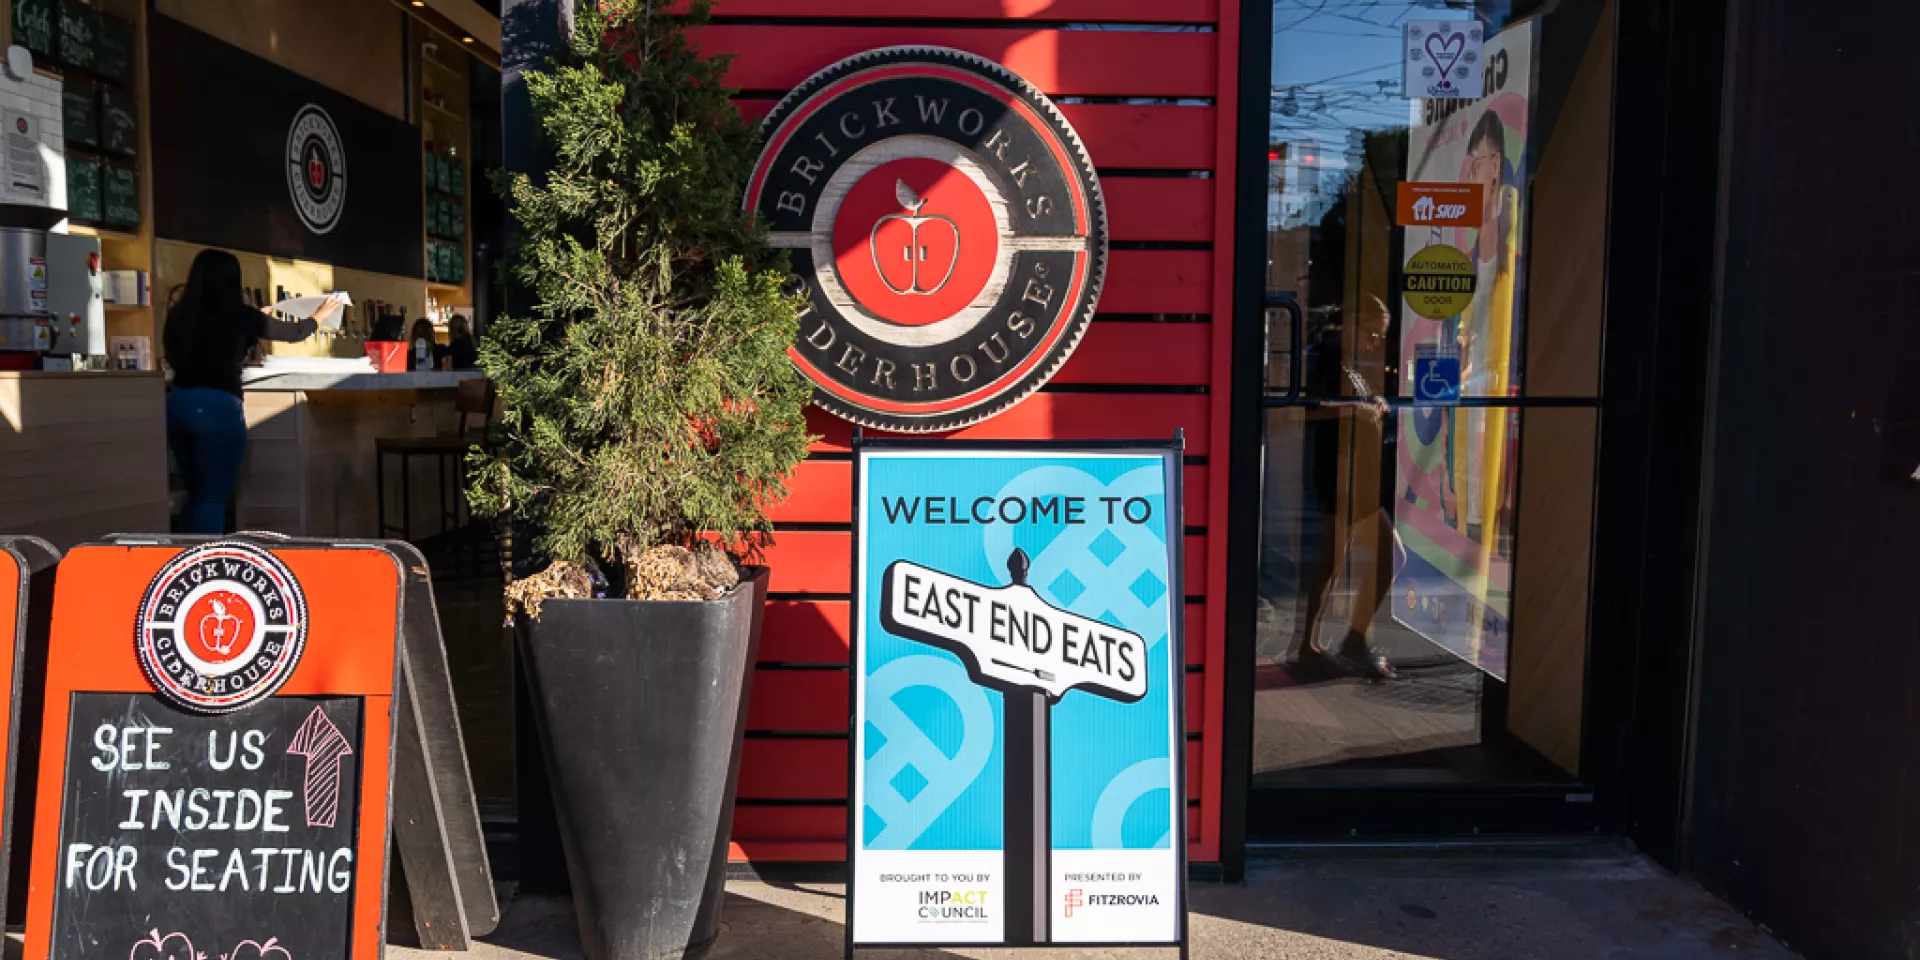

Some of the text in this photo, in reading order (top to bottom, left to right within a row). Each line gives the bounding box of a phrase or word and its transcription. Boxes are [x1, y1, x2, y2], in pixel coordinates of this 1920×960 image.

[777, 95, 1053, 219] BRICKWORKS
[1435, 204, 1467, 219] SKIP
[1411, 260, 1467, 270] AUTOMATIC
[1407, 275, 1471, 290] CAUTION
[1424, 296, 1453, 305] DOOR
[881, 496, 1152, 524] WELCOME TO
[159, 561, 284, 619] BRICKWORKS
[903, 573, 1136, 682] EAST END EATS
[157, 637, 283, 693] CIDERHOUSE
[90, 723, 270, 772] SEE US
[118, 787, 294, 832] INSIDE
[65, 843, 354, 893] FOR SEATING
[879, 873, 990, 882] BROUGHT TO YOU BY
[1064, 873, 1142, 881] PRESENTED BY
[918, 890, 989, 905] IMPACT
[1088, 894, 1160, 905] FITZROVIA
